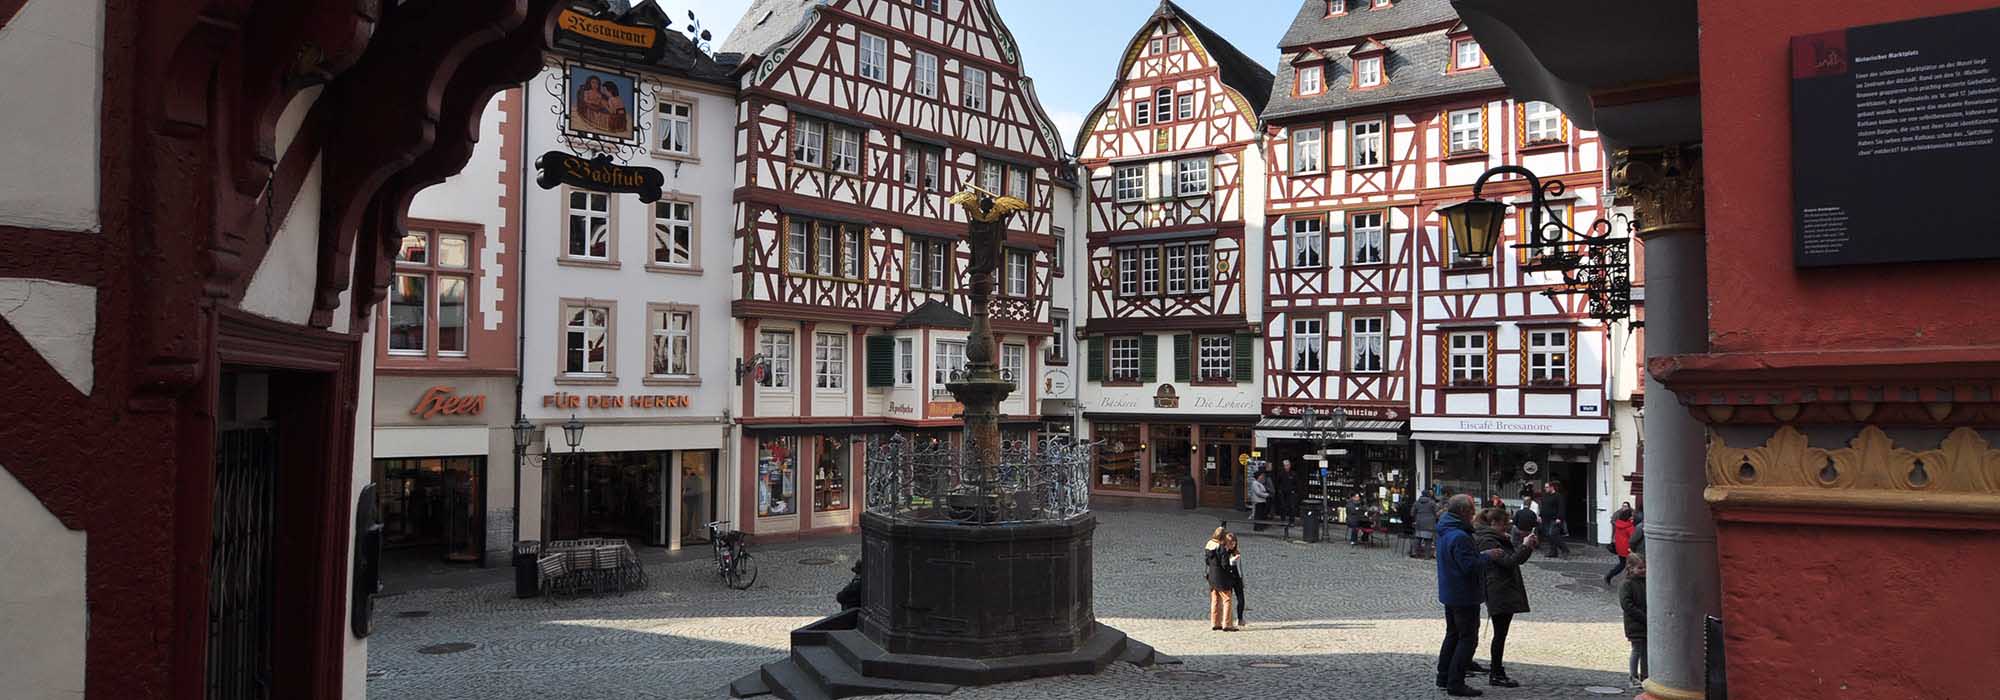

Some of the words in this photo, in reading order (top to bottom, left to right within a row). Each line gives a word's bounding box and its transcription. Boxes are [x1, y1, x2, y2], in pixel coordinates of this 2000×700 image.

[567, 15, 648, 44] Restaurant
[563, 158, 645, 188] Badstub
[410, 385, 486, 420] Hees
[543, 391, 581, 409] FÜR
[587, 395, 625, 409] DEN
[630, 395, 690, 409] HERRN
[1194, 397, 1213, 409] Die
[1497, 421, 1553, 431] Bressanone
